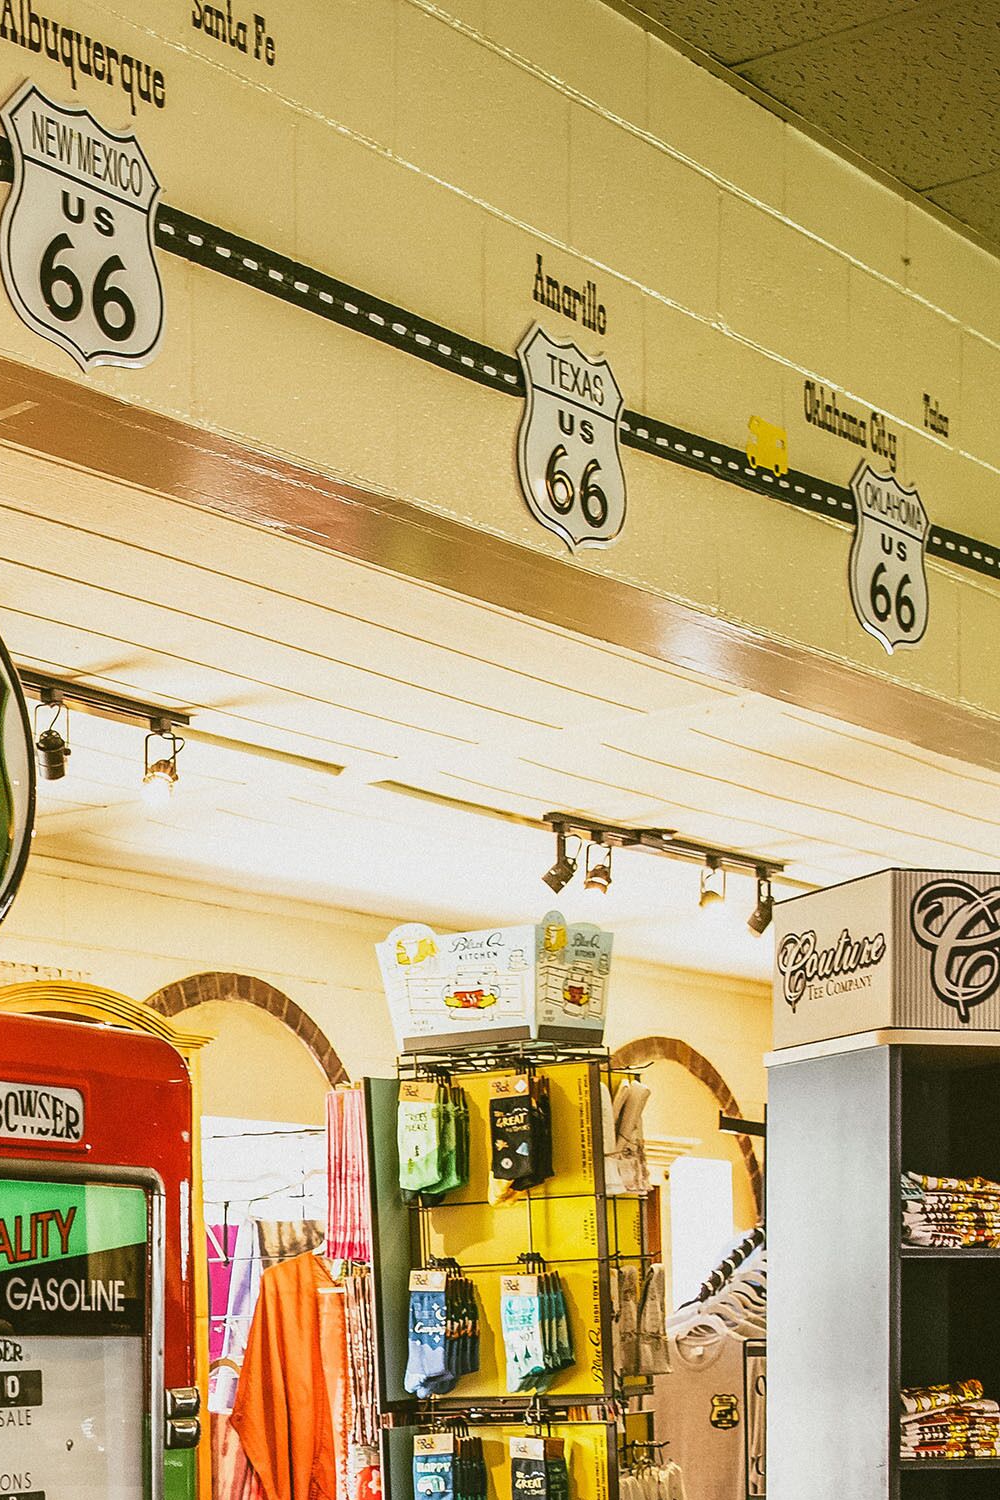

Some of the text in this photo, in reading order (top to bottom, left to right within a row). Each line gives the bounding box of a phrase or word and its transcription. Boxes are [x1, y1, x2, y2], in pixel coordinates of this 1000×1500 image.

[0, 0, 166, 116] Albuquerque
[192, 0, 276, 66] Santa Fe
[31, 111, 144, 197] NEW MEXICO
[40, 233, 136, 341] 66
[533, 253, 607, 335] Amarillo
[546, 352, 605, 407] TEXAS
[804, 380, 897, 473] Oklahoma City
[546, 444, 608, 528] 66
[864, 482, 924, 533] OKLAHOMA
[870, 563, 915, 633] 66
[777, 929, 886, 1014] Couture
[826, 974, 873, 997] COMPANY
[6, 1277, 125, 1311] GASOLINE
[590, 1349, 605, 1387] Blue
